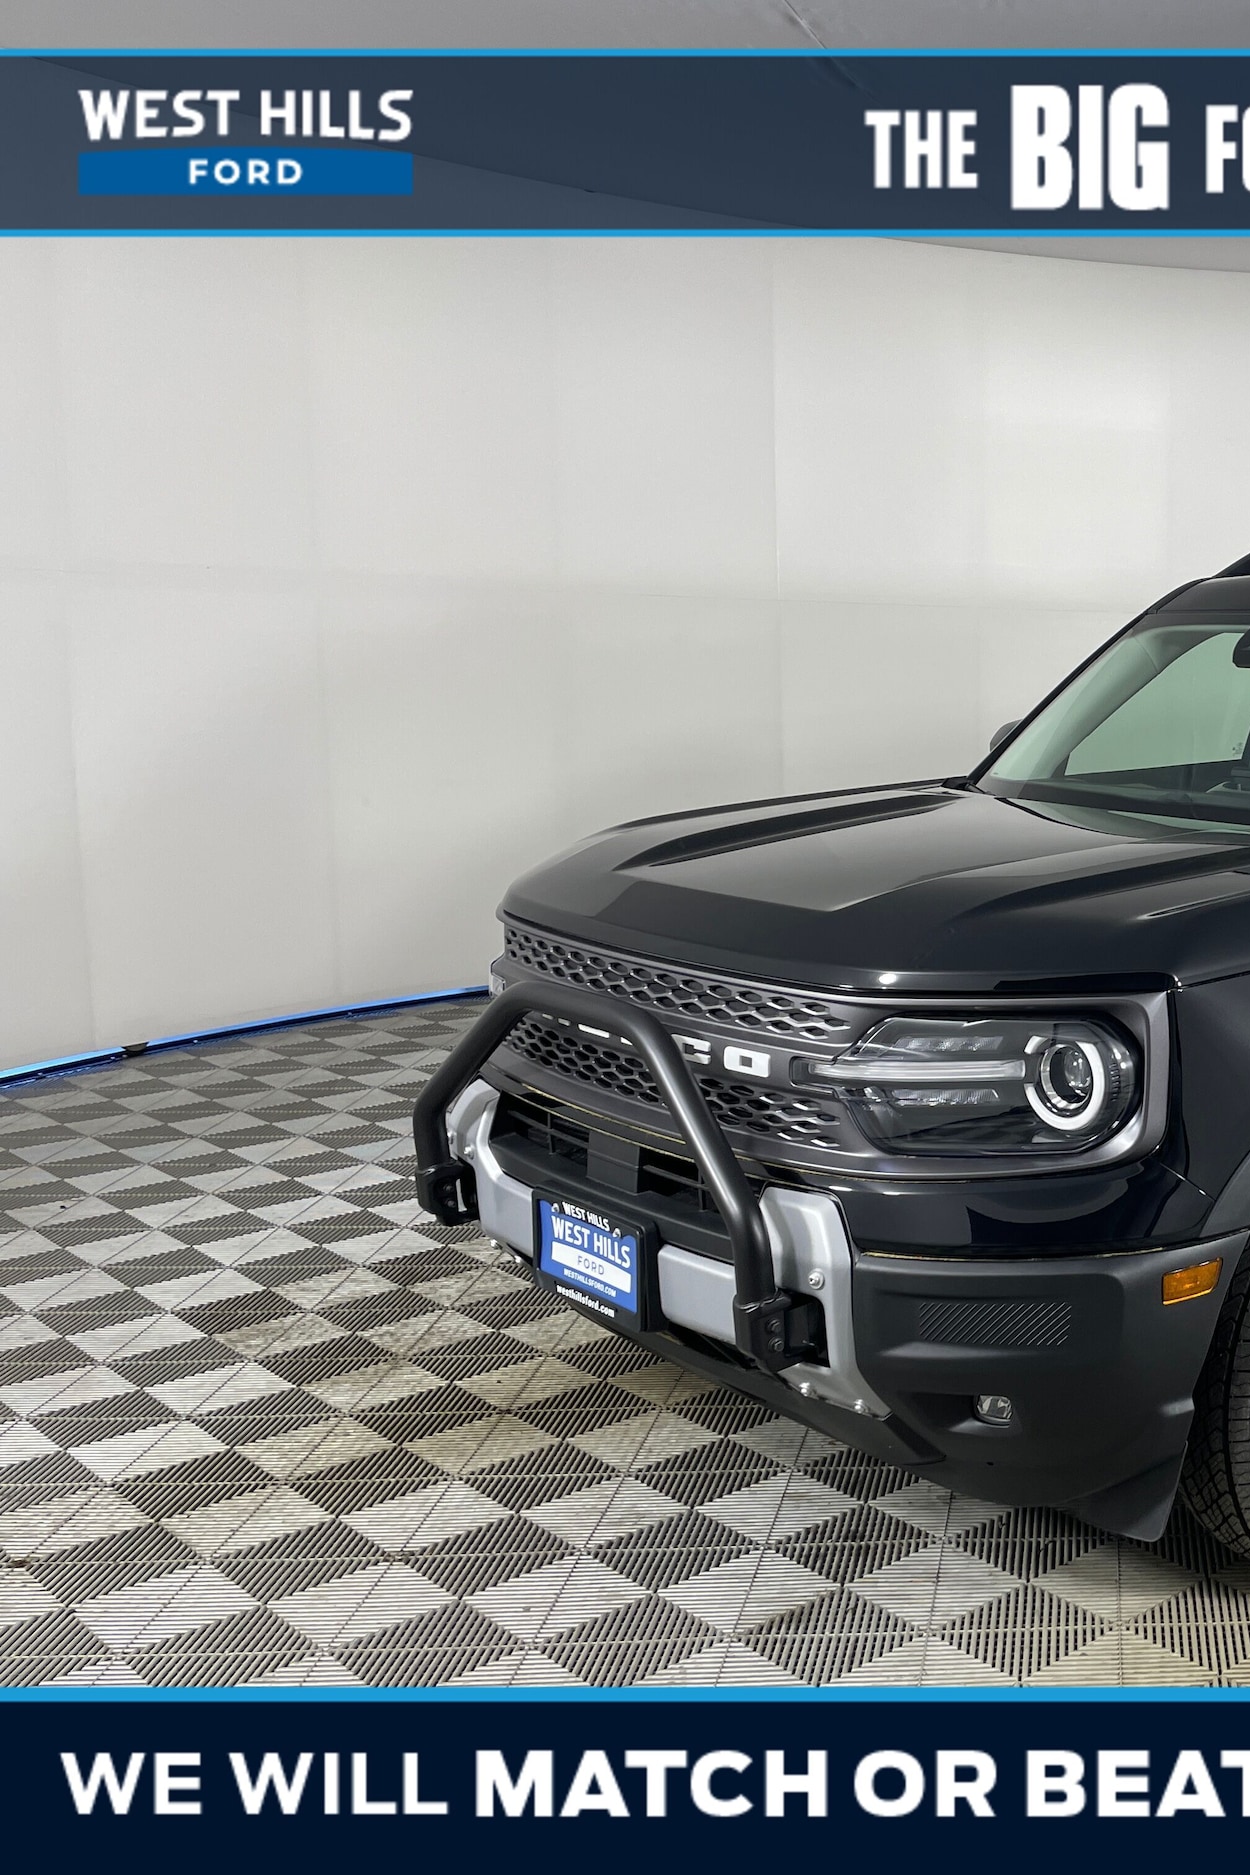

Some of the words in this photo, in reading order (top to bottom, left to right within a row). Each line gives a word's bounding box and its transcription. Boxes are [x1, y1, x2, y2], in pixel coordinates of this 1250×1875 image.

[561, 1201, 587, 1220] WEST
[586, 1211, 611, 1232] HILLS
[550, 1215, 591, 1249] WEST
[593, 1232, 631, 1269] HILLS
[576, 1255, 606, 1276] FORD
[562, 1267, 617, 1298] WESTHILLSFORD.COM
[556, 1284, 615, 1318] westhillsford.com
